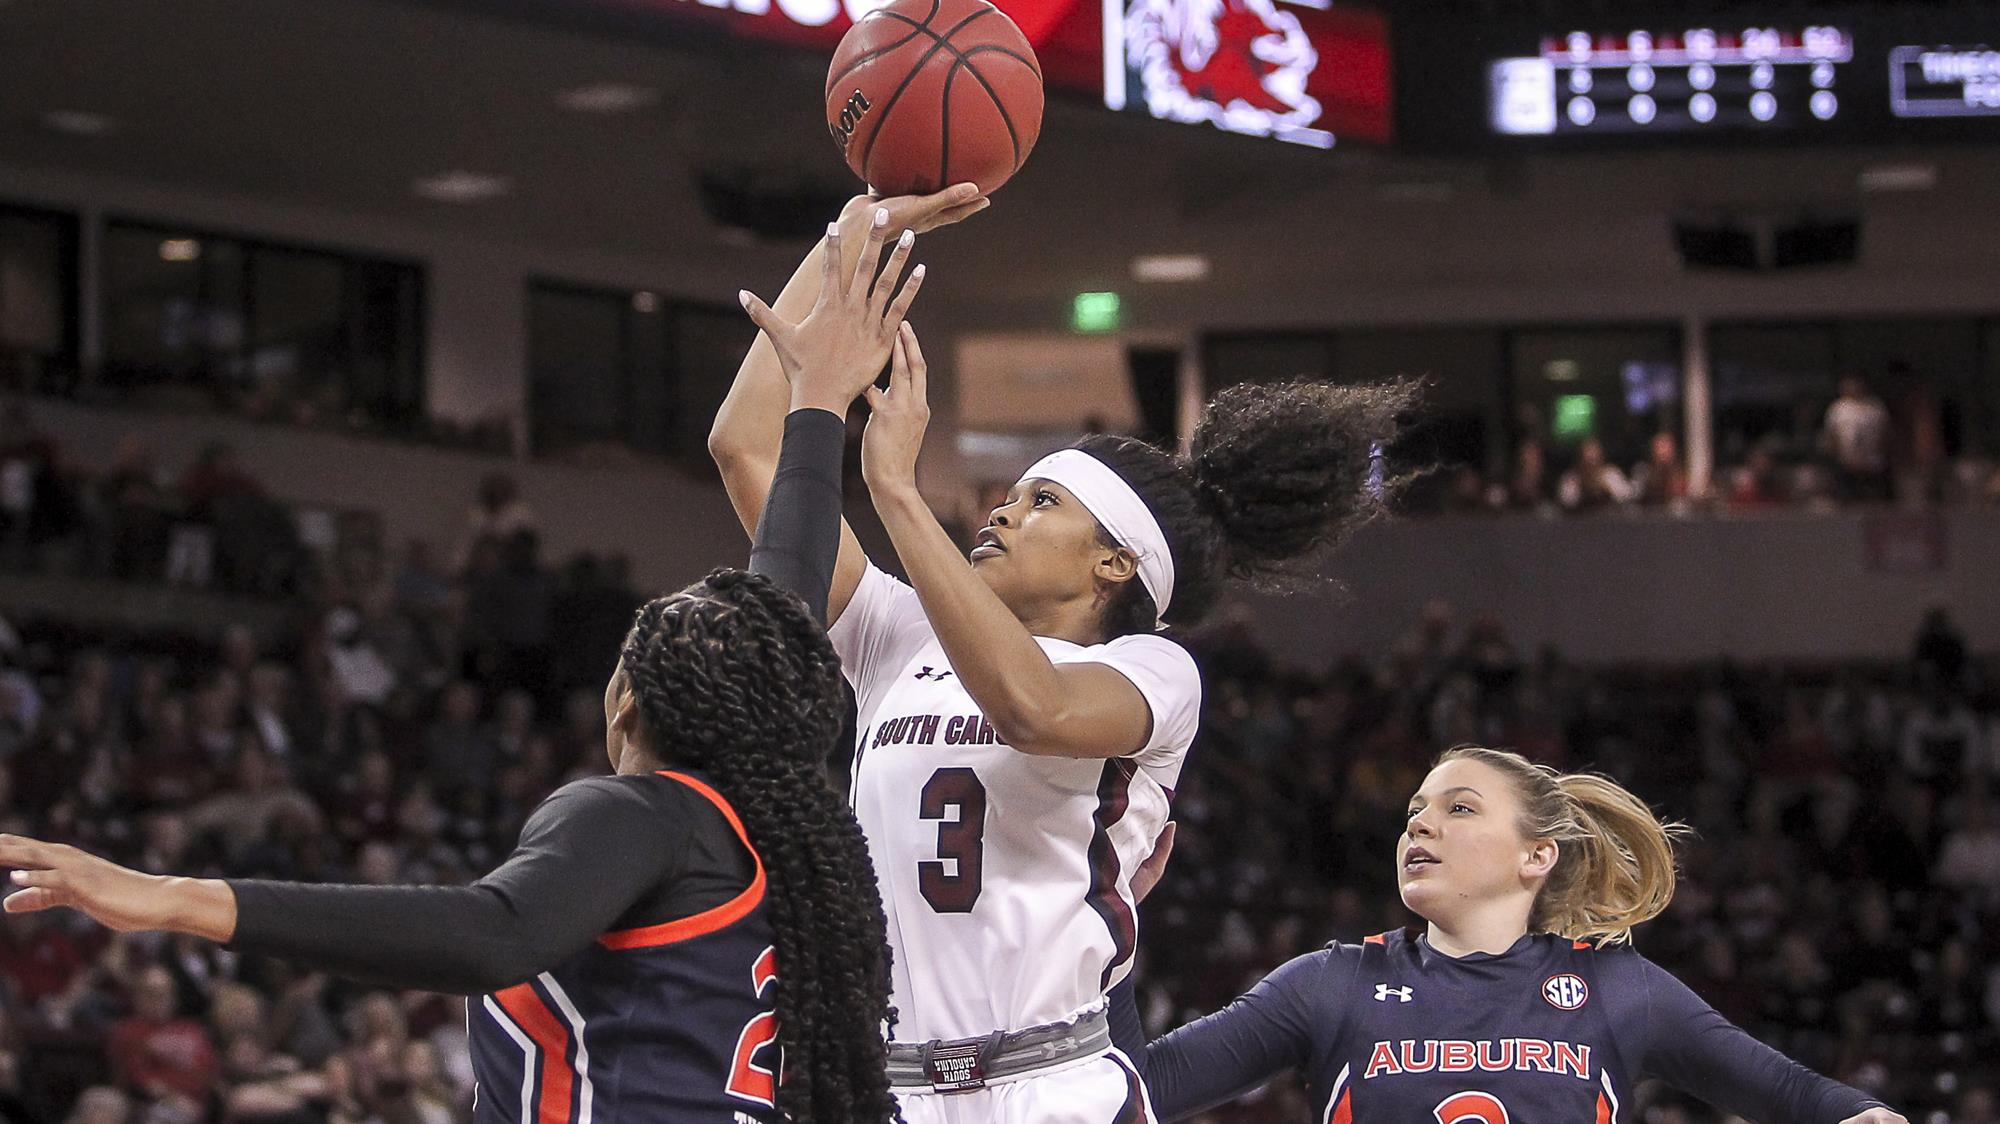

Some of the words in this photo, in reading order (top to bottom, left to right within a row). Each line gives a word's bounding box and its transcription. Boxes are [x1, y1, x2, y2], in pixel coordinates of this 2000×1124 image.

[872, 714, 941, 750] SOUTH
[917, 767, 987, 913] 3
[1545, 976, 1585, 1007] SEC
[934, 1056, 976, 1072] CAROLINA
[943, 1068, 971, 1083] SOUTH
[1363, 1037, 1591, 1081] AUBURN
